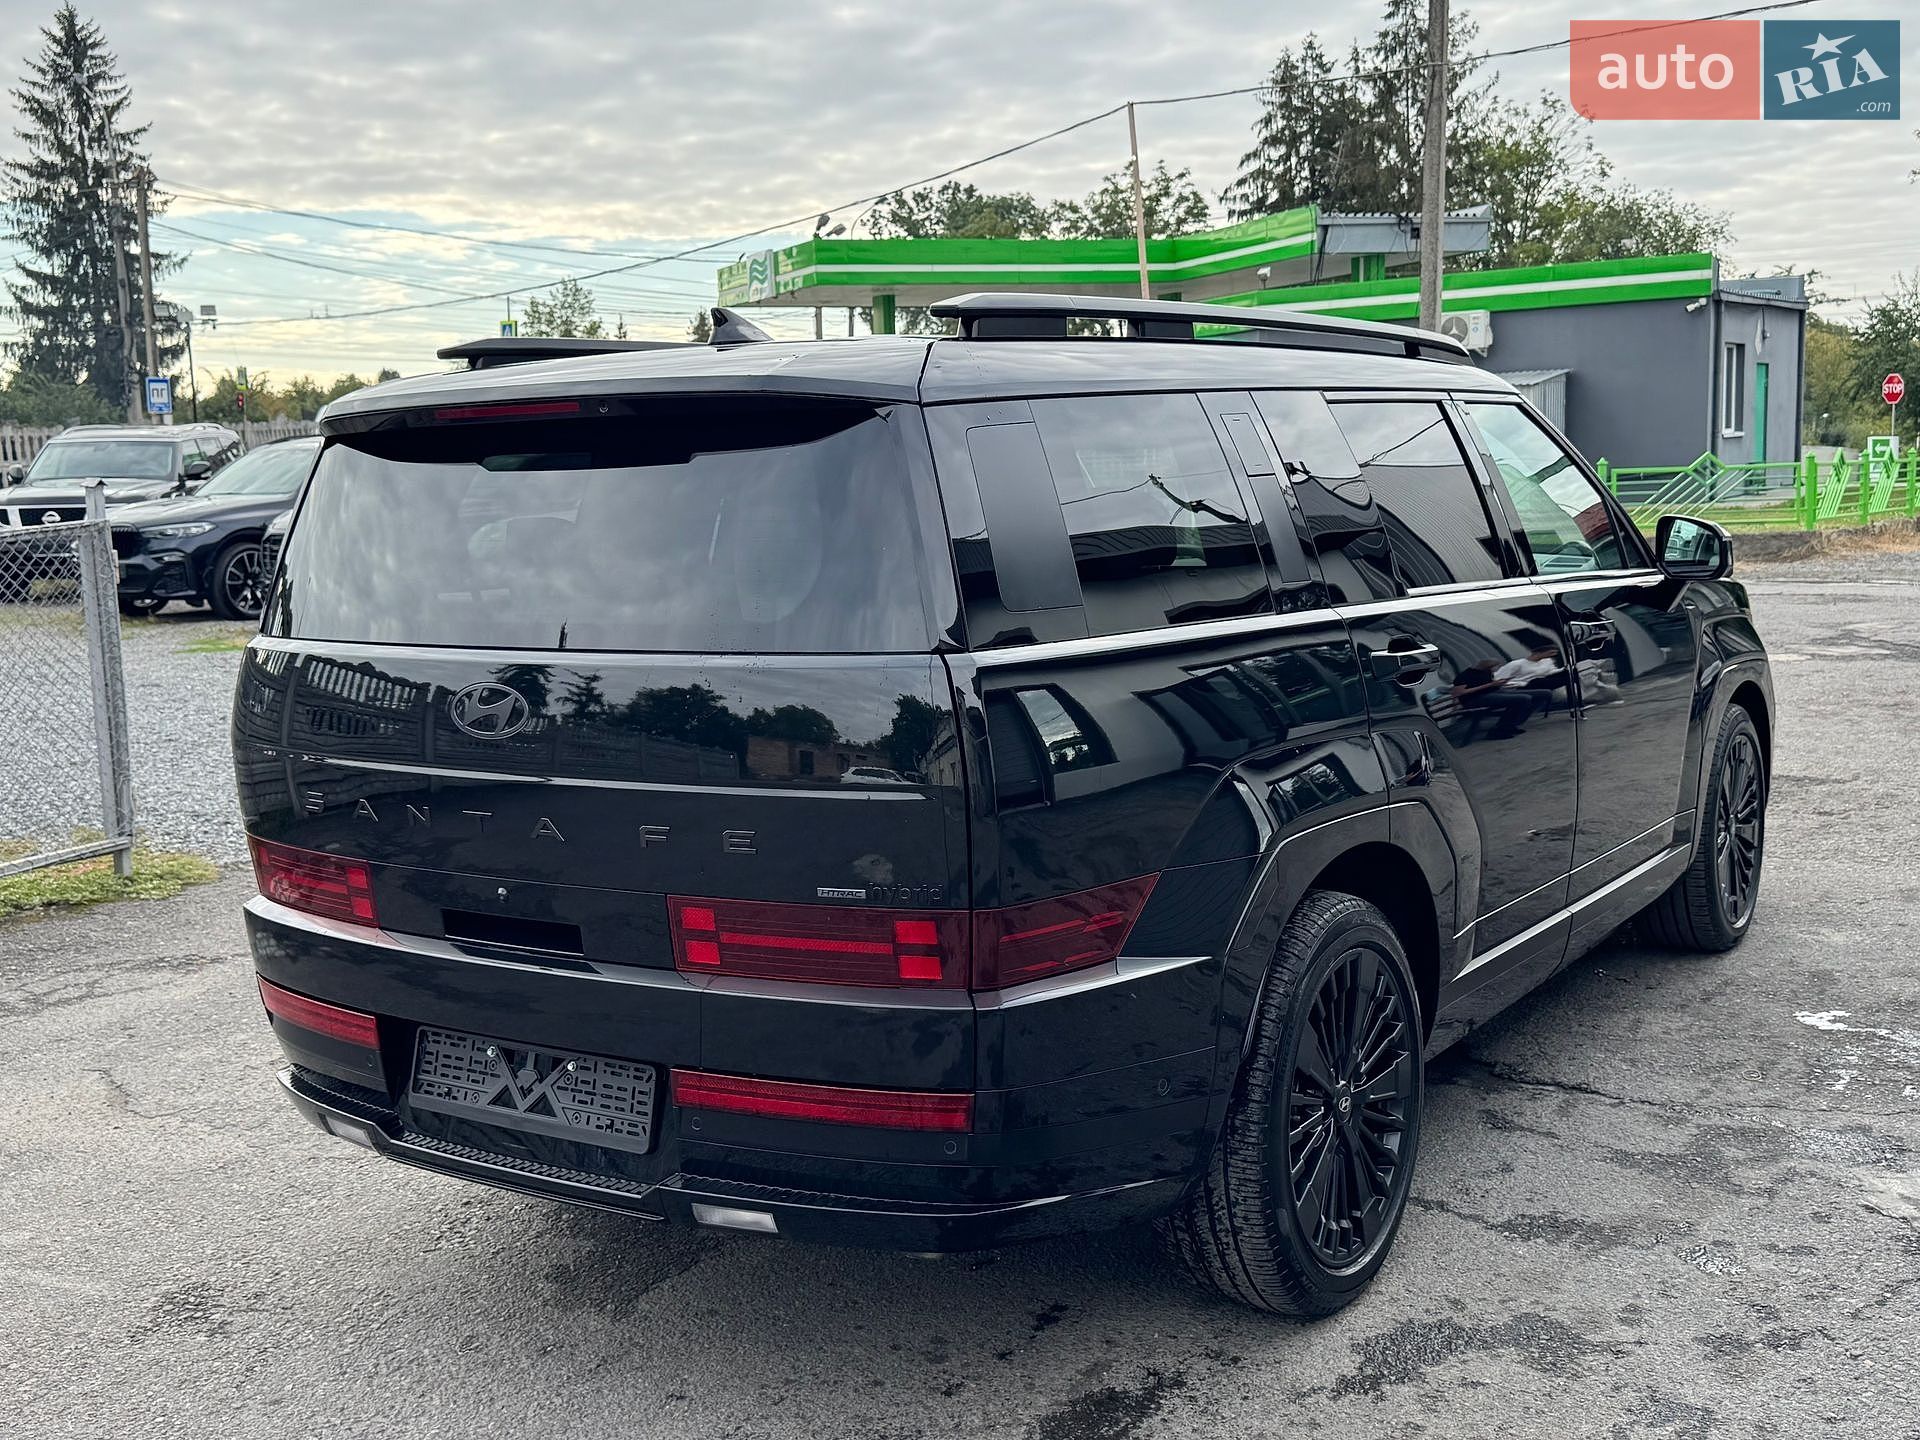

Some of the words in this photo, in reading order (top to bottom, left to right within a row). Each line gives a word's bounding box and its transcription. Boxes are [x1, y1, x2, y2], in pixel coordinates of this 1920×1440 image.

[1883, 383, 1904, 394] STOP
[304, 790, 566, 843] SANTA
[639, 824, 759, 856] FE
[867, 881, 943, 904] hybrid
